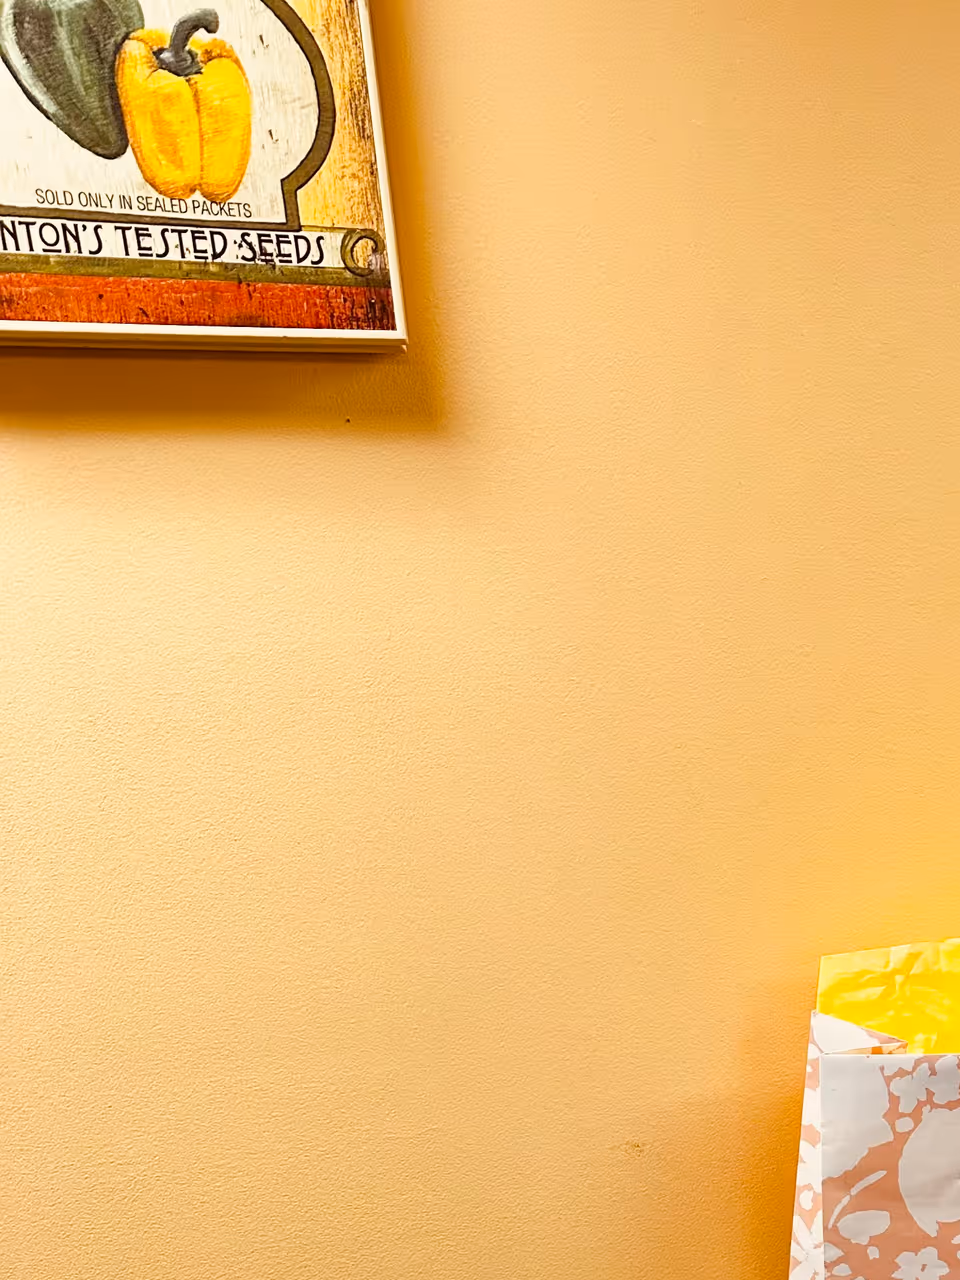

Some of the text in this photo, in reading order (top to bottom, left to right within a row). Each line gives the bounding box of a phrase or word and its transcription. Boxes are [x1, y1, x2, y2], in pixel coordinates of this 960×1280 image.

[35, 189, 252, 218] SOLD ONLY IN SEALED PACKETS
[114, 225, 228, 261] TESTED
[240, 232, 325, 266] SEEDS
